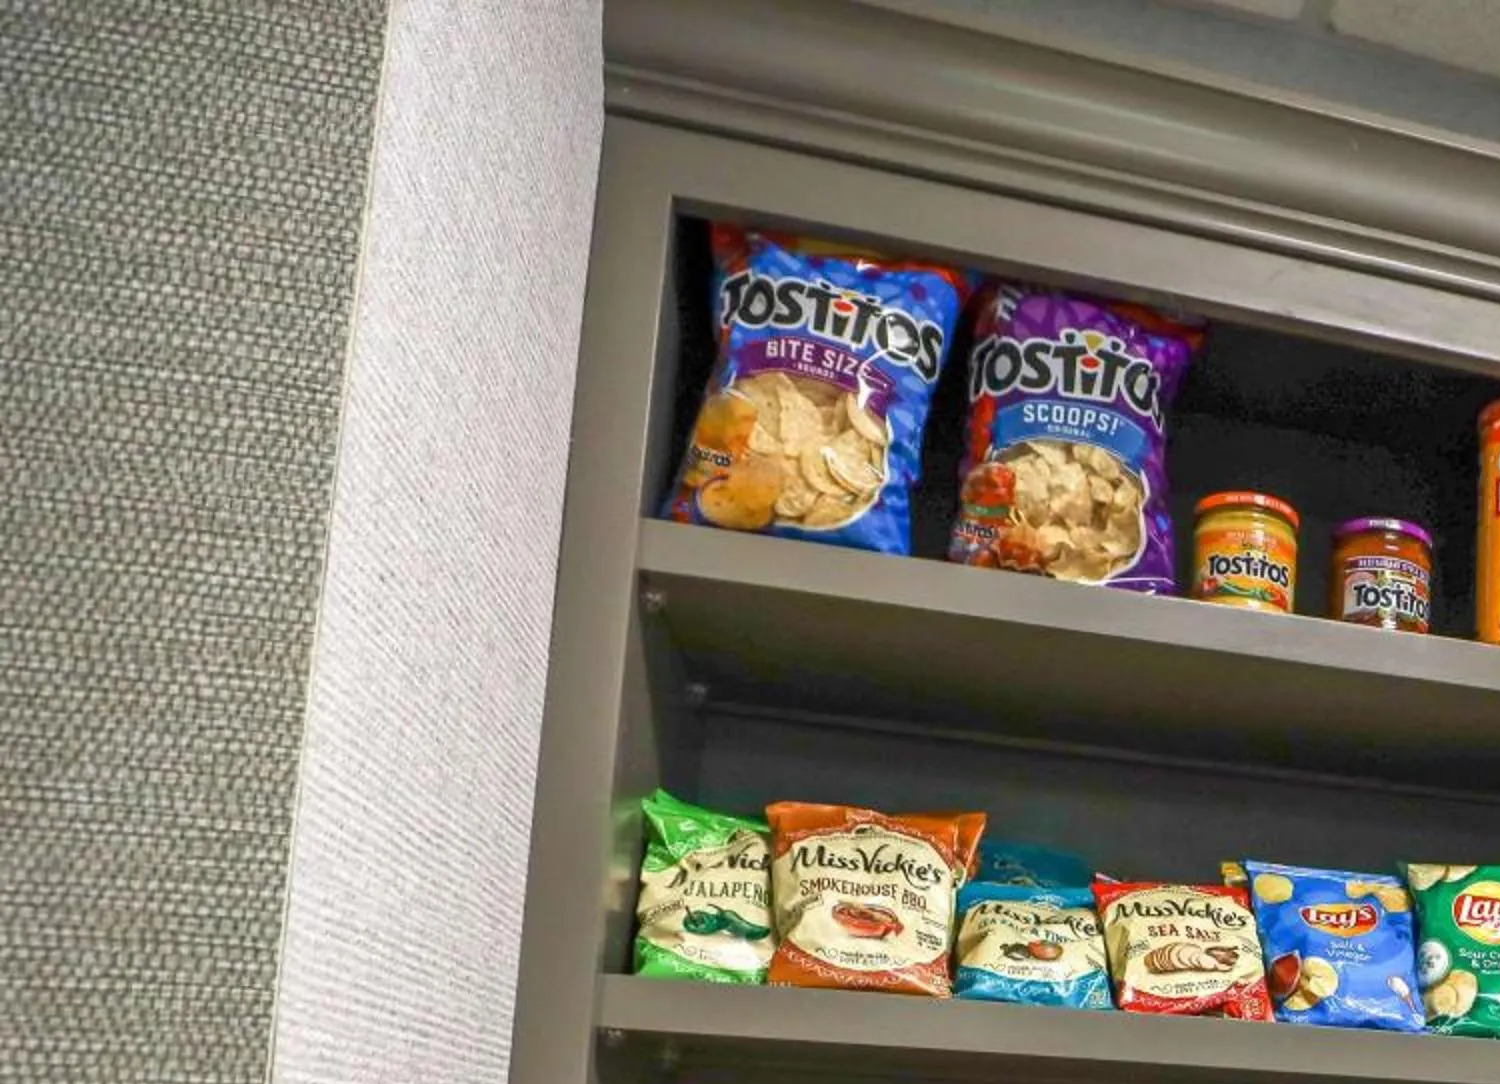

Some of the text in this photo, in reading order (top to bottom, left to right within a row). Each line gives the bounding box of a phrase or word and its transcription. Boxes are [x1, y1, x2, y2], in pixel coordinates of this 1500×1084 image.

[719, 269, 943, 384] TOSTITOS
[766, 340, 814, 363] BITE
[1023, 404, 1118, 436] SCOOPS!
[1208, 552, 1289, 588] TOSTITOS
[790, 844, 859, 873] Miss
[800, 878, 928, 911] SMOKEHOUSE BBQ
[1111, 901, 1173, 927] Miss
[1148, 923, 1222, 942] SEA SALT
